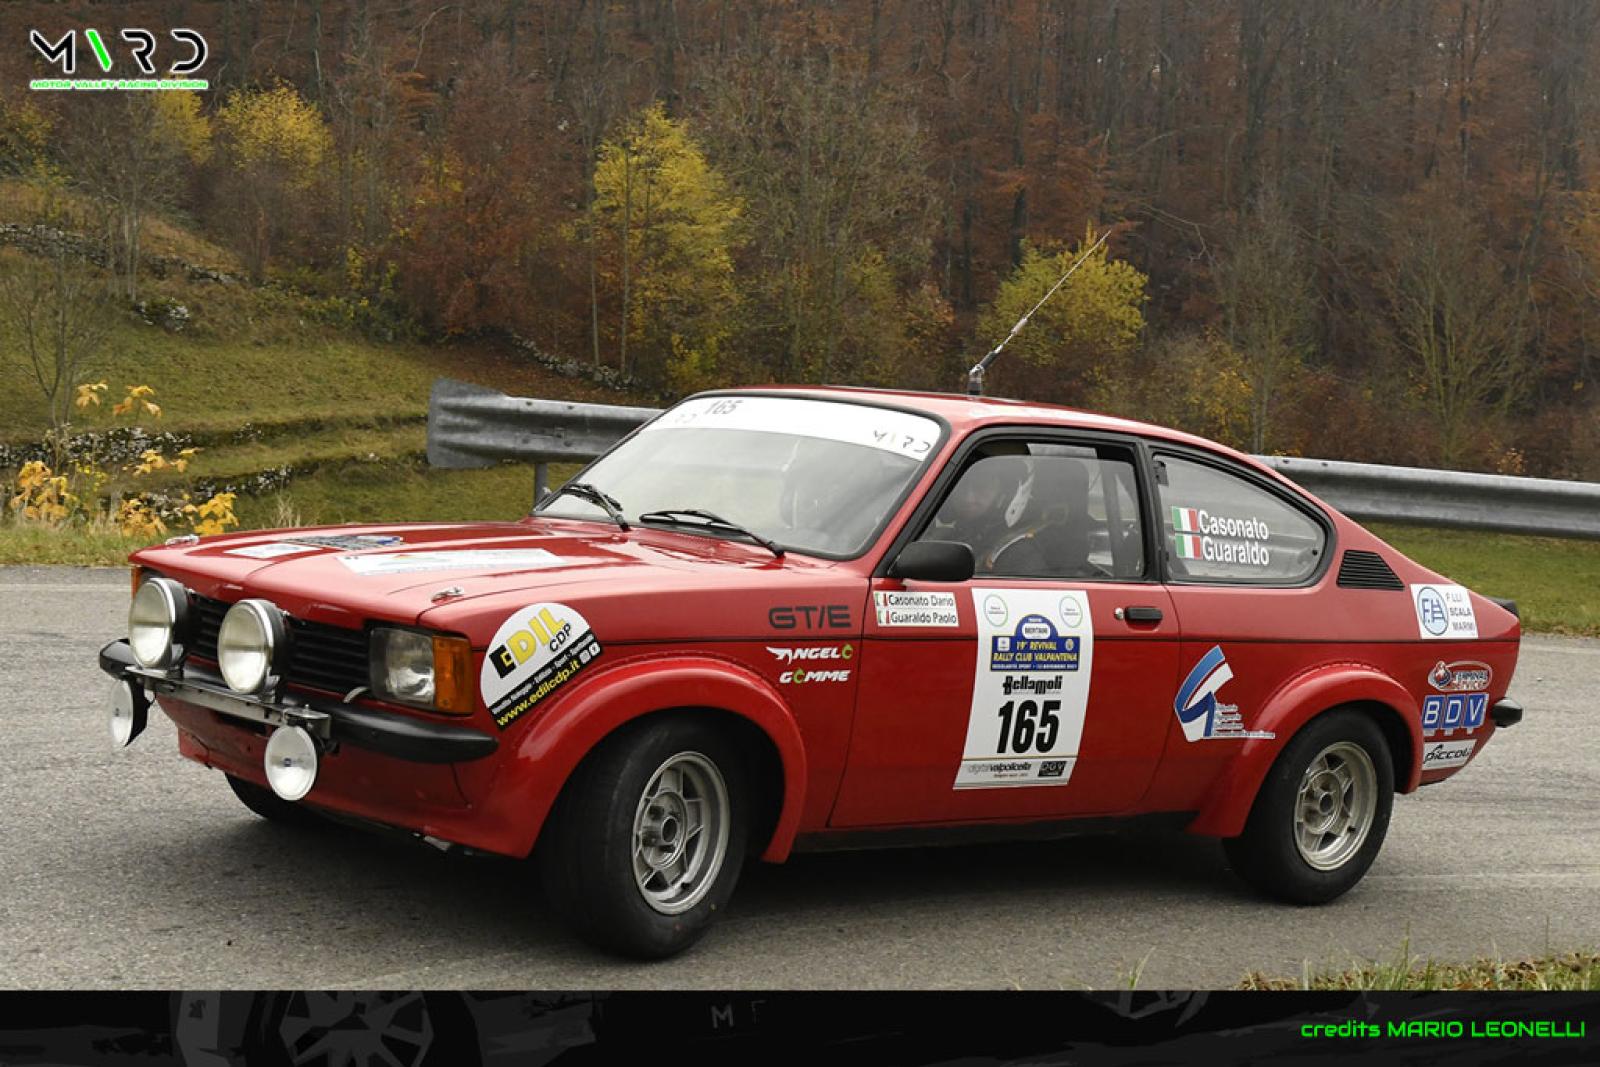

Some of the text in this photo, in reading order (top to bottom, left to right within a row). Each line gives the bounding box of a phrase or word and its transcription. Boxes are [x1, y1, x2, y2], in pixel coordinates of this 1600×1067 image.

[703, 399, 743, 414] 165
[1199, 510, 1269, 540] Casonato
[1203, 536, 1269, 567] Guaraldo
[888, 594, 954, 606] Casonato Dario
[768, 605, 852, 629] GT/E
[891, 611, 957, 623] Guaraldo Paolo
[1449, 607, 1472, 617] SCALA
[489, 607, 565, 679] EDIL
[549, 623, 571, 652] CDP
[1029, 641, 1057, 650] REVIVAL
[766, 644, 853, 665] ANGELO
[992, 652, 1014, 661] RALLY
[1015, 652, 1032, 661] CLUB
[779, 668, 850, 684] GOMME
[497, 660, 580, 726] www.edilcdp.it
[1424, 698, 1484, 724] BDV
[997, 700, 1061, 754] 165
